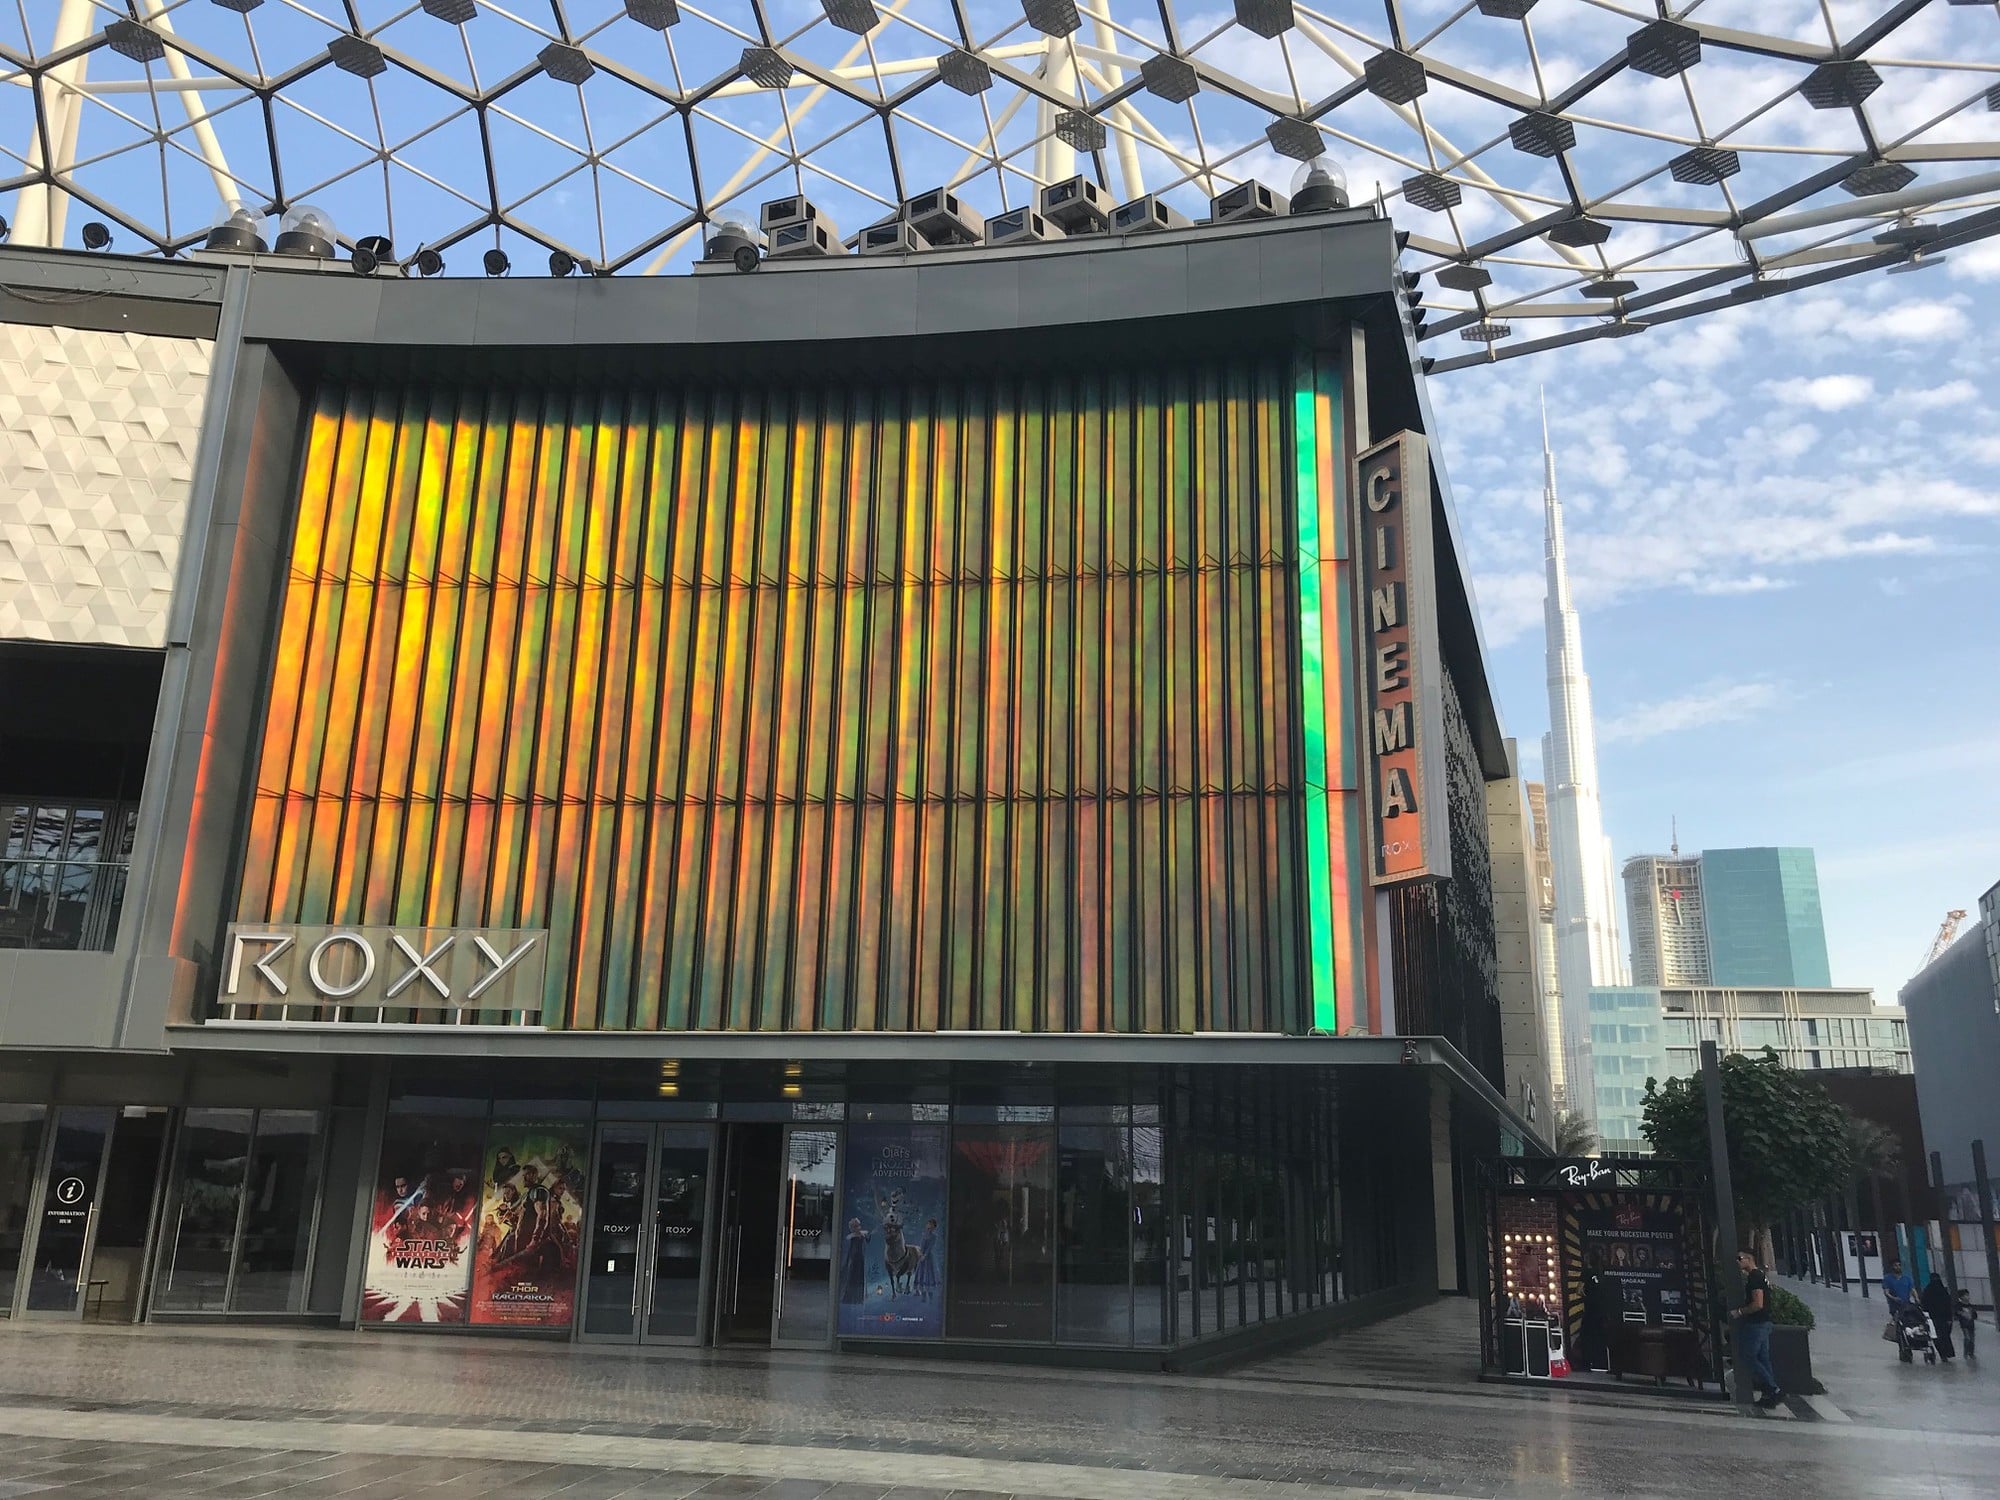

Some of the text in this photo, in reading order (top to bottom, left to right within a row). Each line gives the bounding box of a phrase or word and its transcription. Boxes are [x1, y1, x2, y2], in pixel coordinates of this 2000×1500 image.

[1366, 464, 1416, 819] CINEMA
[1381, 840, 1416, 858] ROX
[227, 931, 537, 999] ROXY
[603, 1225, 631, 1233] ROXY
[665, 1226, 693, 1234] ROXY
[794, 1228, 822, 1237] ROXY
[1587, 1229, 1674, 1240] MAKE YOUR ROCKSTAR POSTER
[396, 1239, 450, 1252] STAR
[395, 1256, 449, 1269] WARS
[492, 1293, 555, 1301] RAGNAROK
